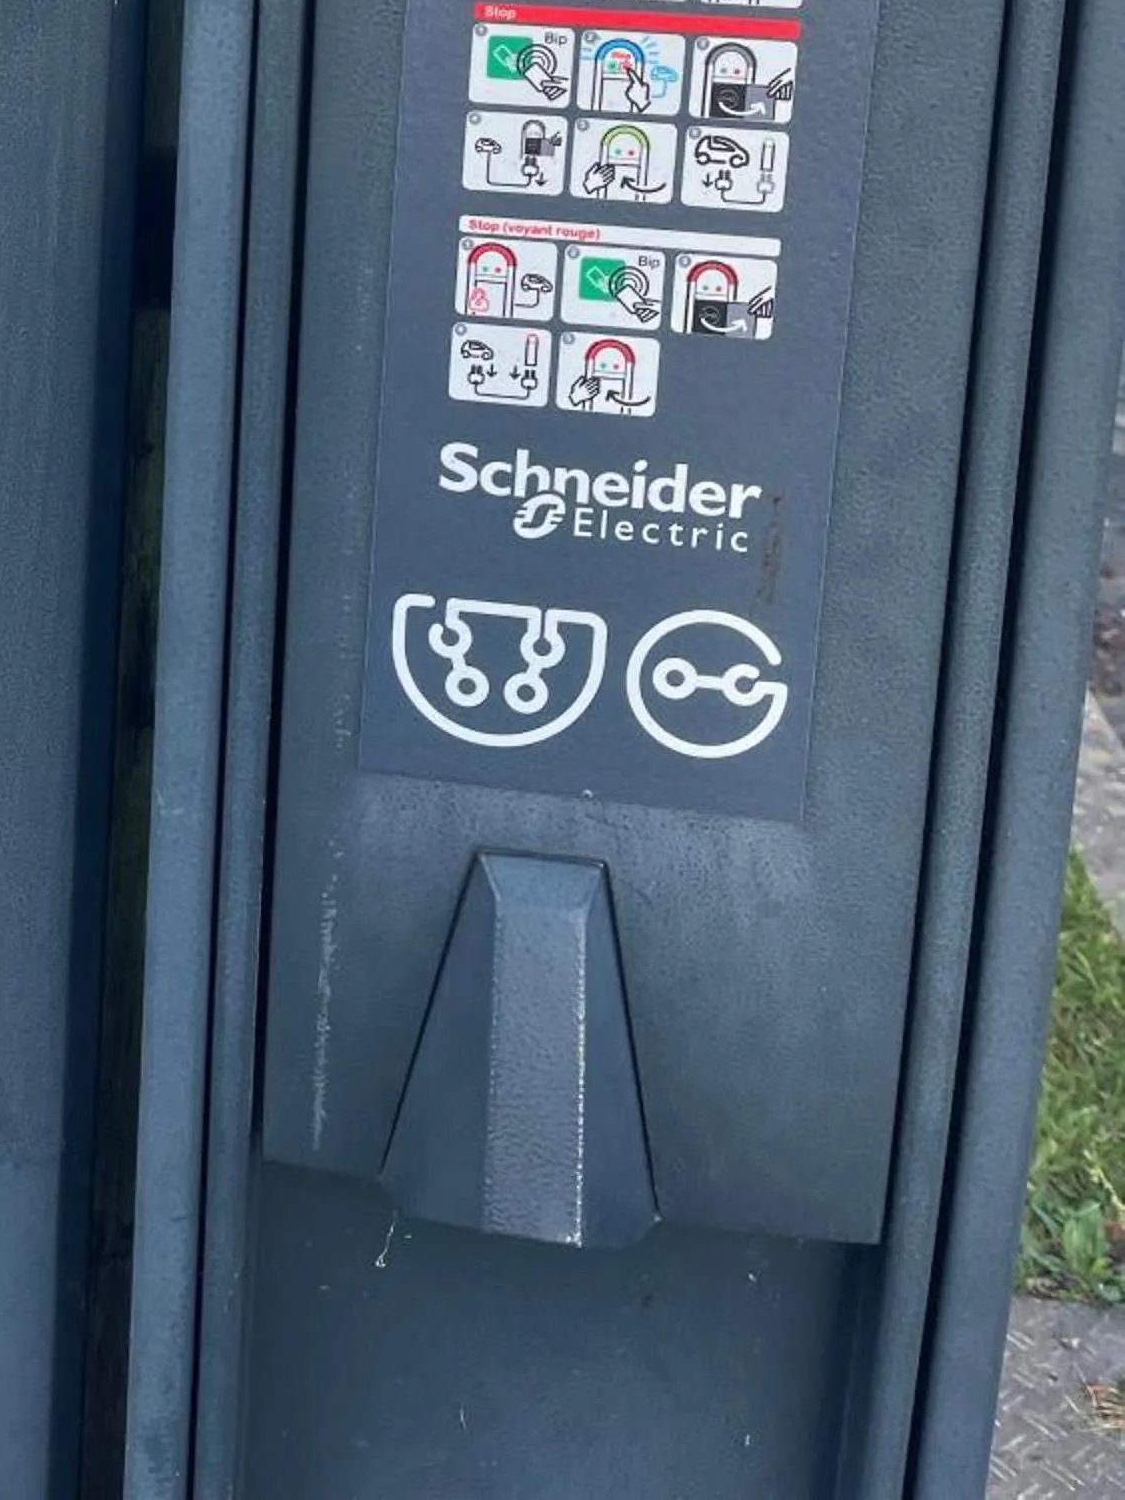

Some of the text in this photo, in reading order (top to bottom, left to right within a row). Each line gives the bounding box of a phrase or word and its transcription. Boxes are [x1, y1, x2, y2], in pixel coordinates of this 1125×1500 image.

[484, 4, 516, 20] Stop
[544, 32, 568, 46] Bip
[469, 219, 601, 241] Stop (voyant rouge)
[638, 255, 661, 271] Bip
[439, 442, 762, 519] Schneider
[573, 506, 748, 553] Electric
